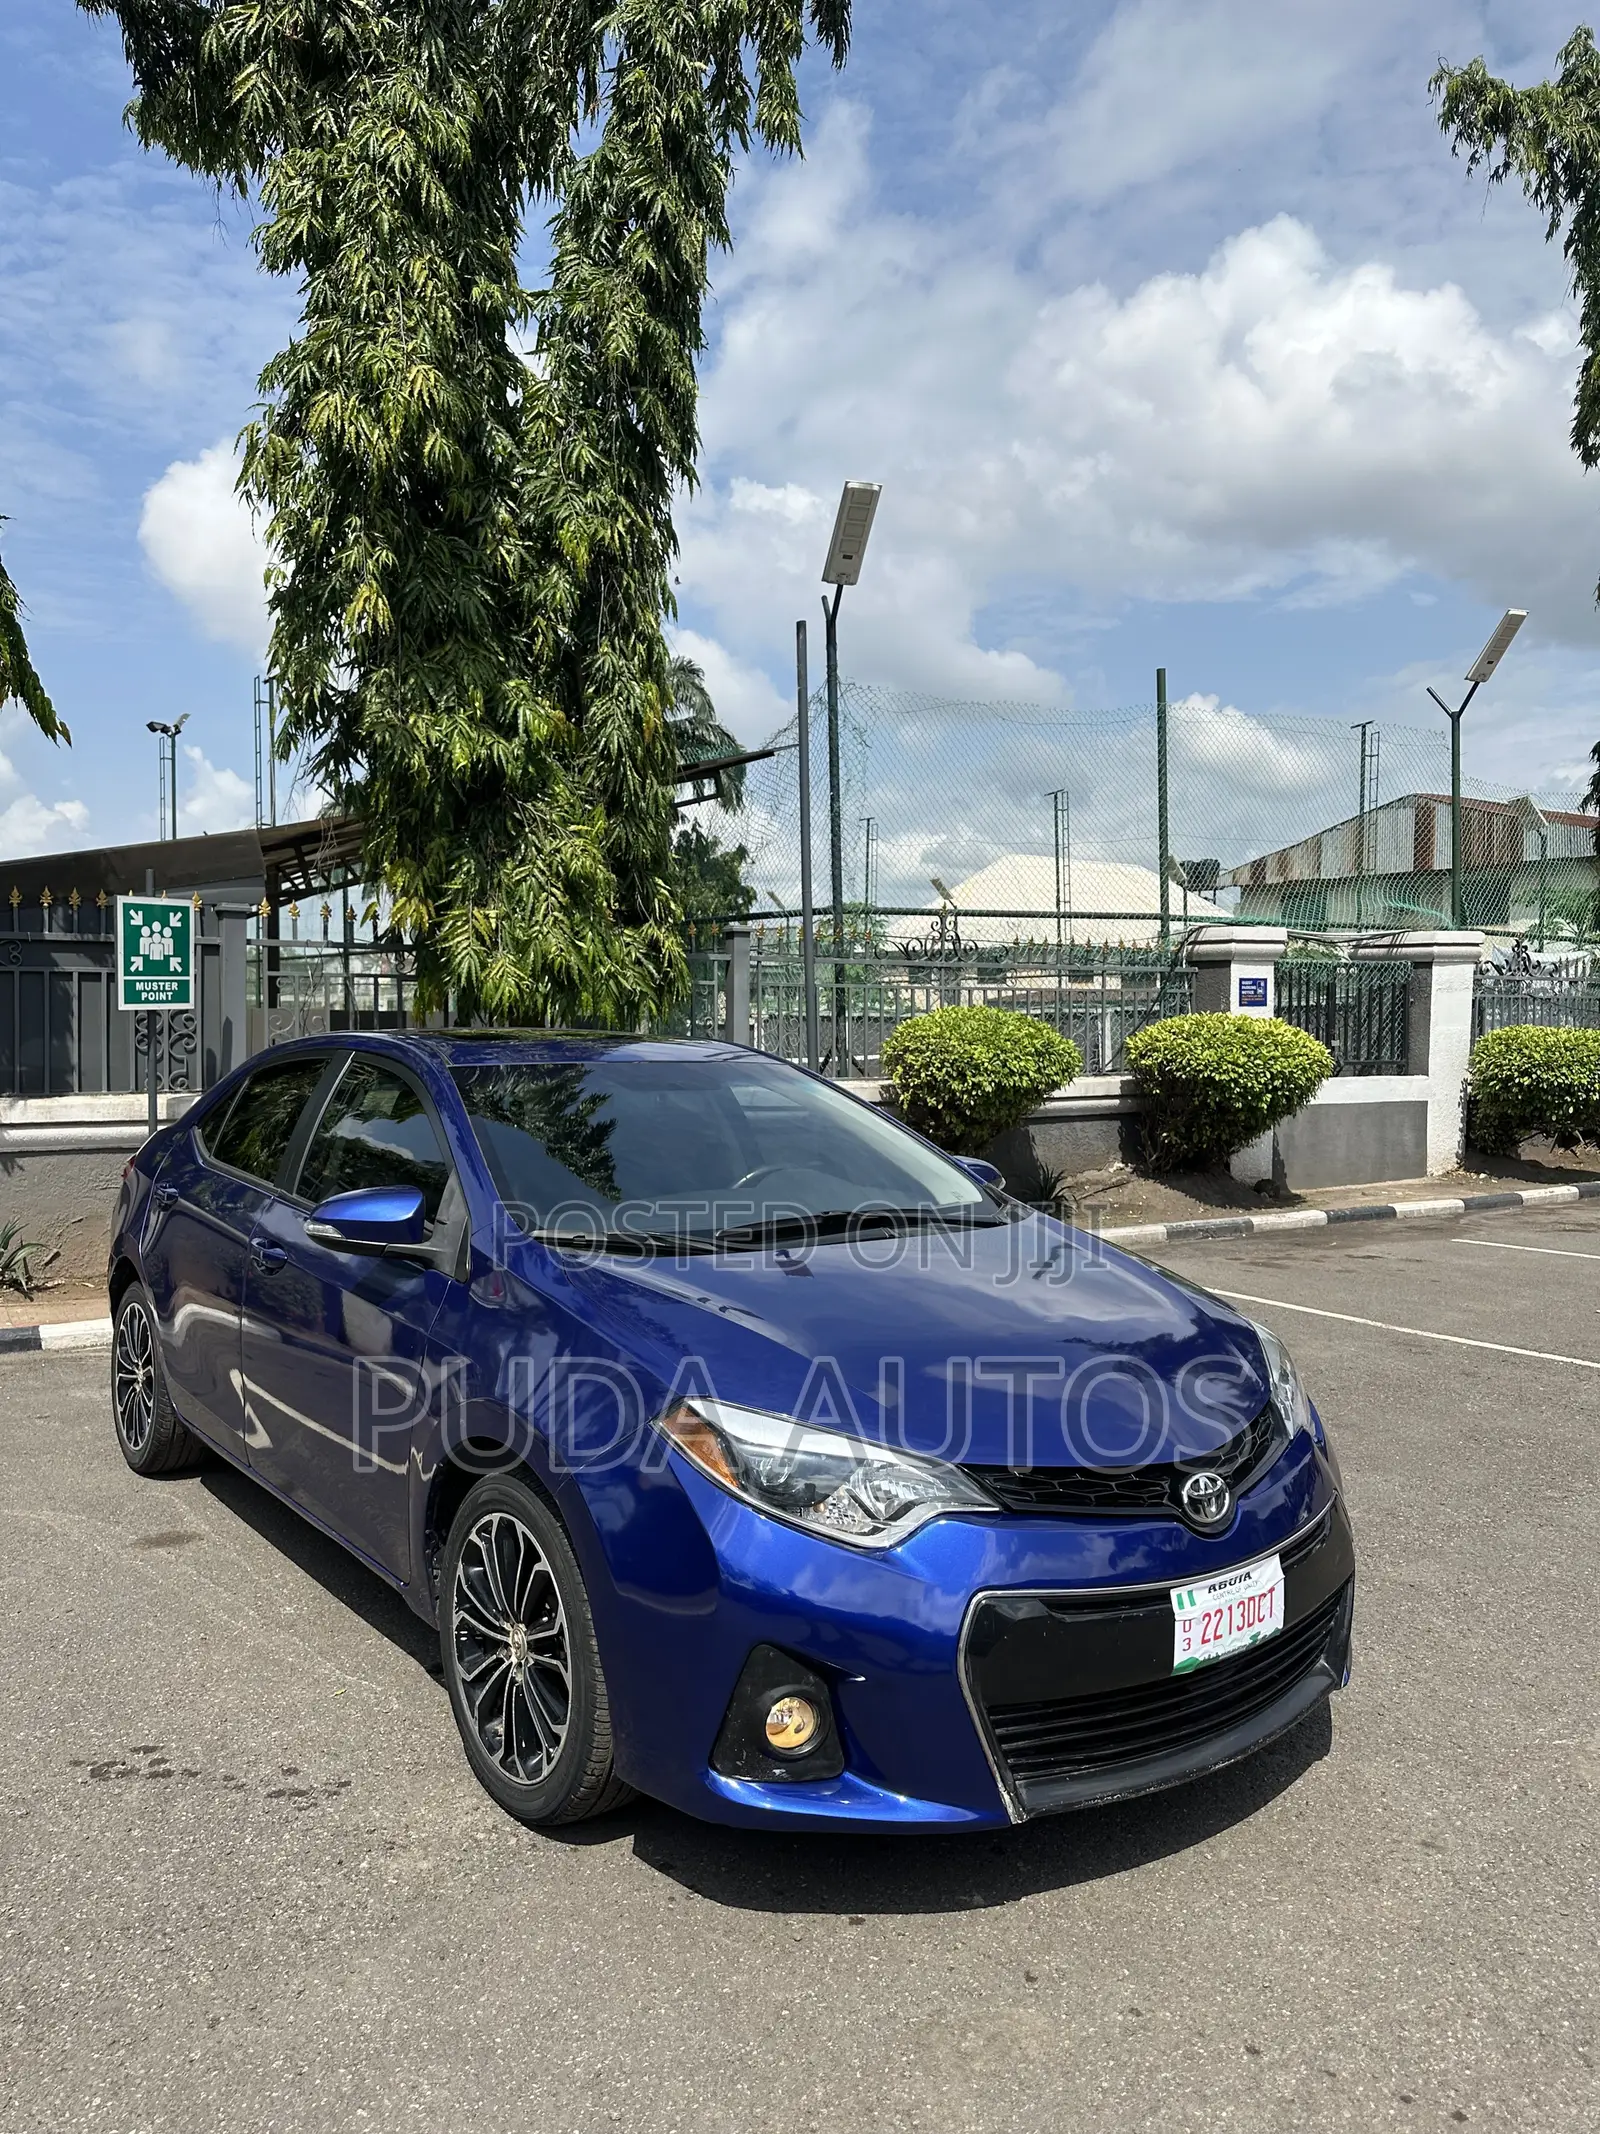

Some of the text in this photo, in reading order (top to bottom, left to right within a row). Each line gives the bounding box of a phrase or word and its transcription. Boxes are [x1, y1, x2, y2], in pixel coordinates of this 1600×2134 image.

[136, 982, 178, 991] MUSTER
[141, 992, 174, 1001] POINT
[1212, 1589, 1235, 1601] CENTRE
[1201, 1586, 1275, 1645] 2213DCT
[1182, 1637, 1191, 1651] 3
